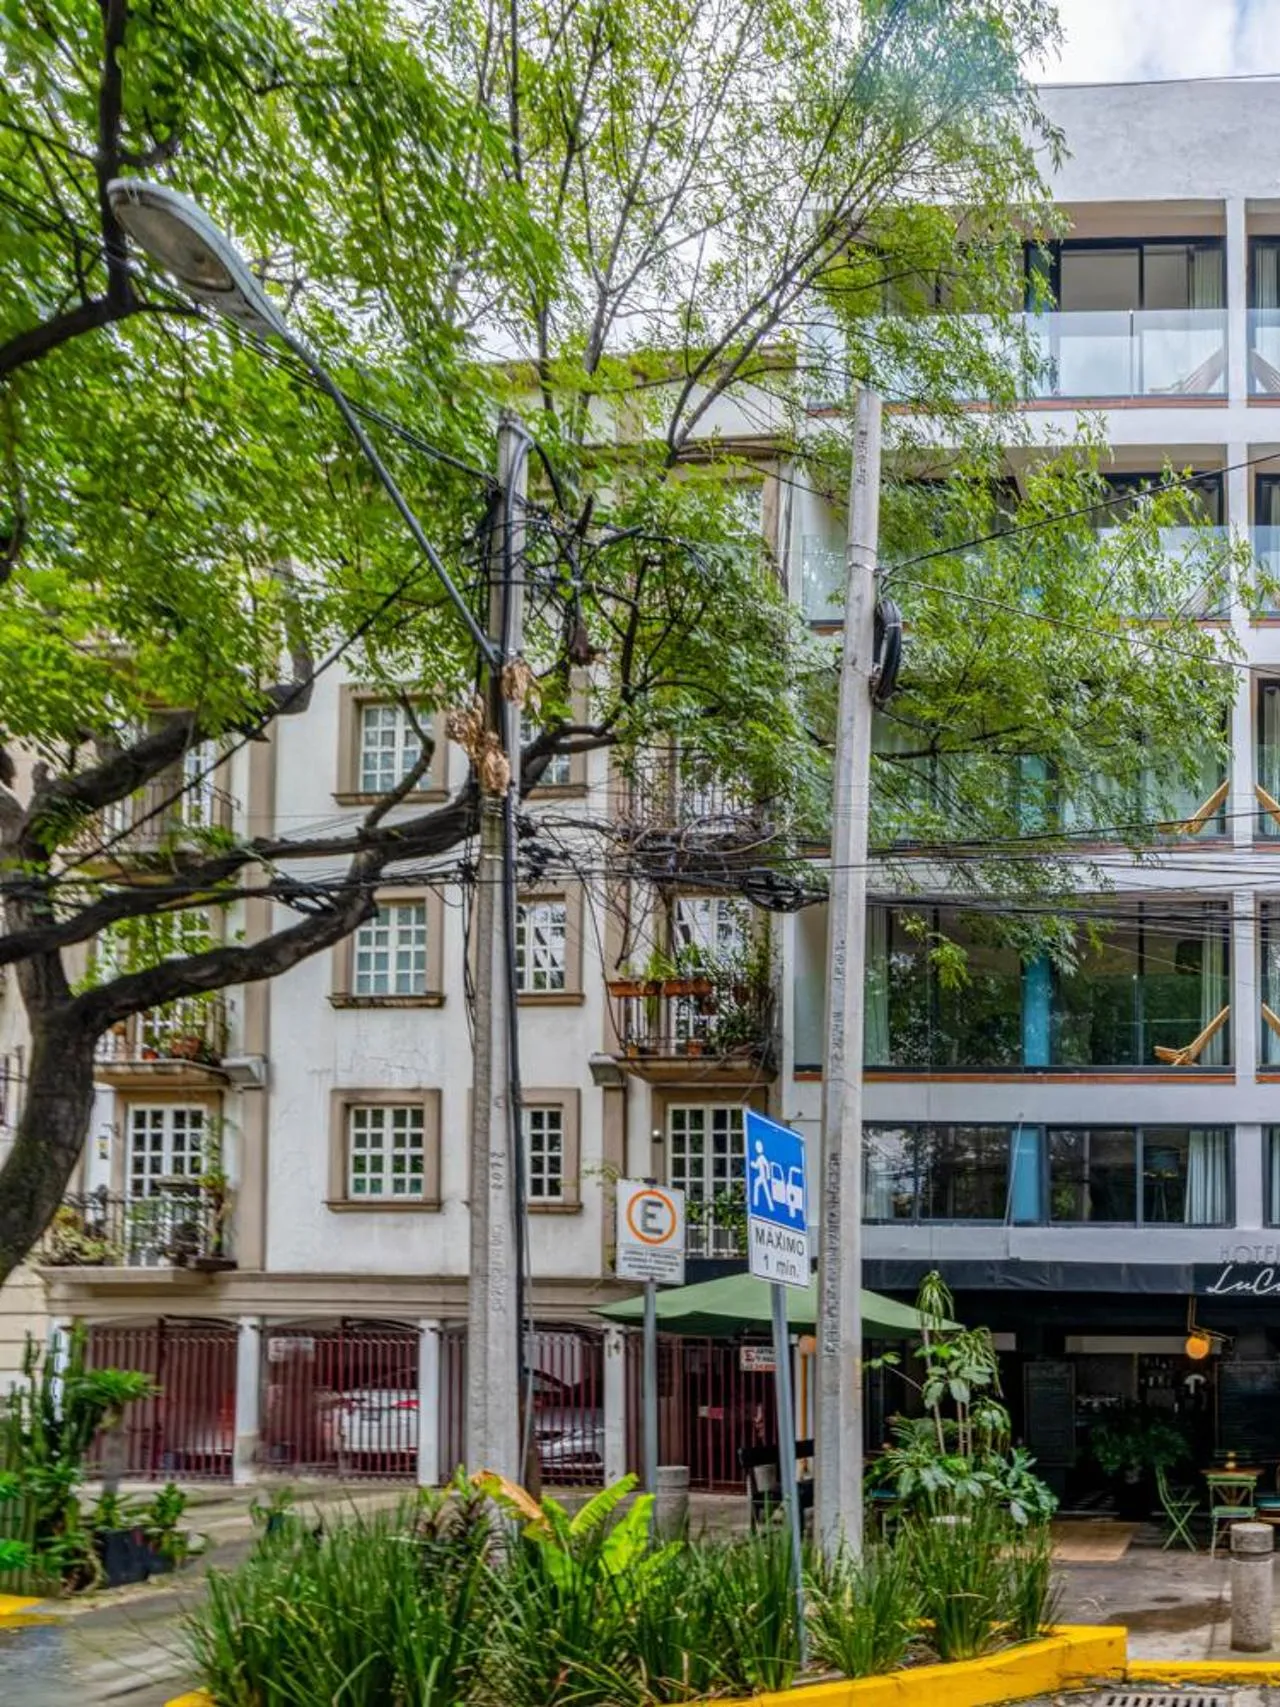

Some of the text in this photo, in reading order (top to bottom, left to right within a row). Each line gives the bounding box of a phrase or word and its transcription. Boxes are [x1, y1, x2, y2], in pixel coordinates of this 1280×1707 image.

[640, 1200, 663, 1235] E
[764, 1254, 769, 1271] 1
[1219, 1244, 1280, 1263] HOTEL
